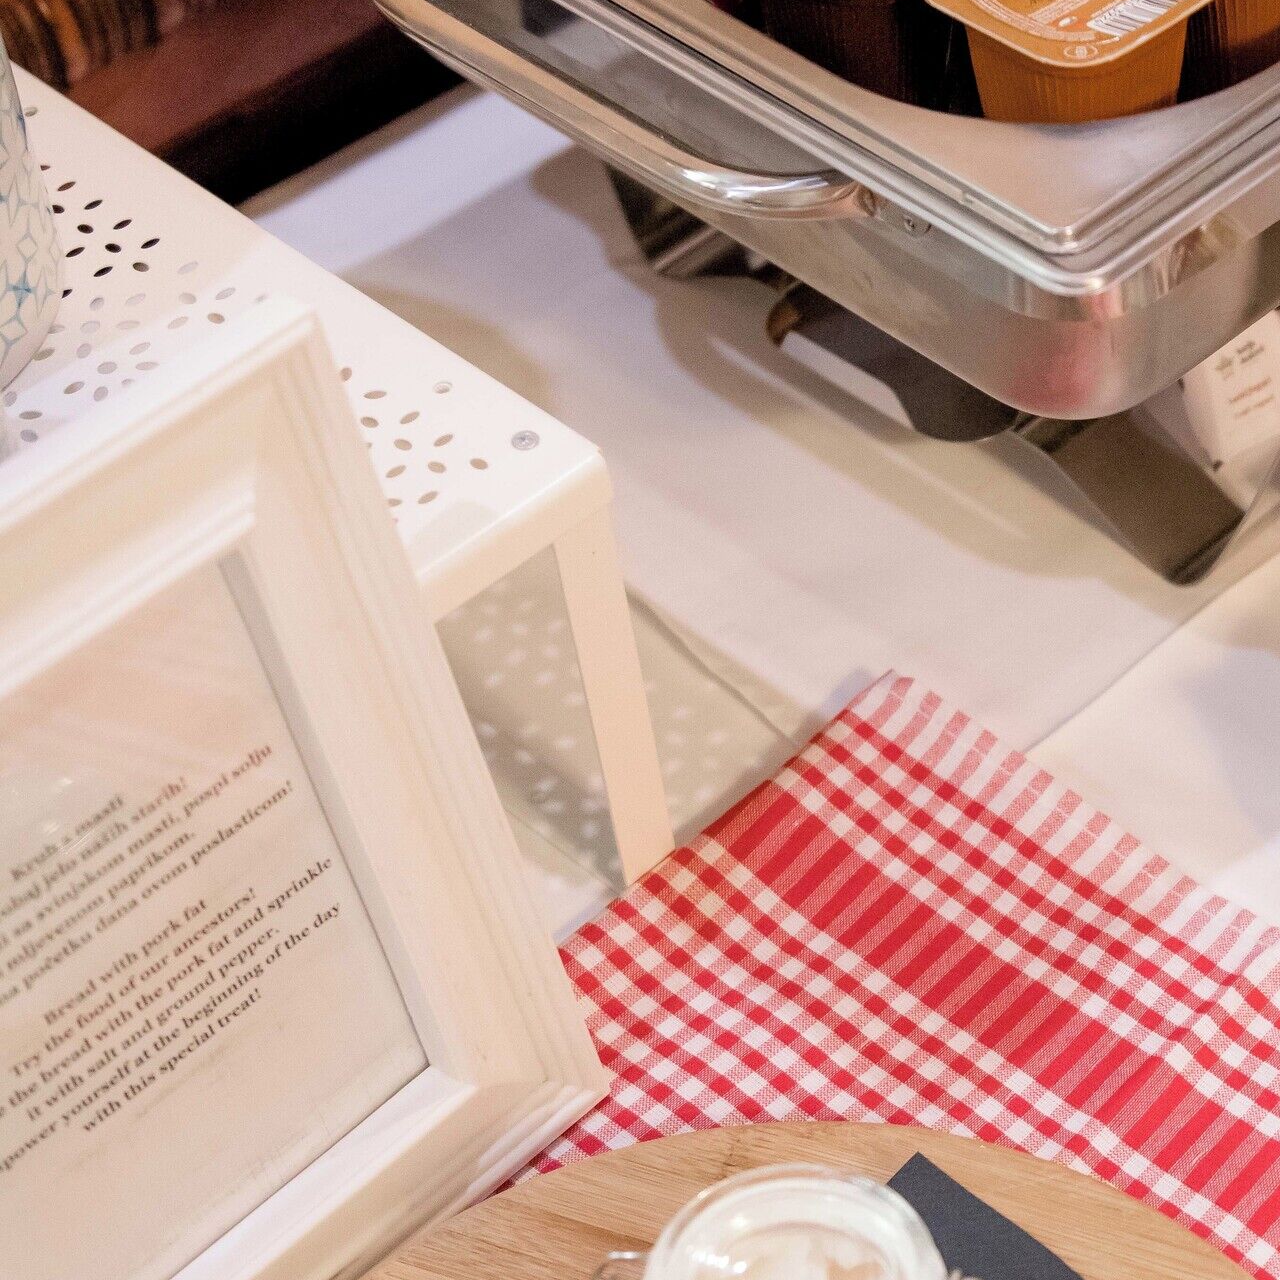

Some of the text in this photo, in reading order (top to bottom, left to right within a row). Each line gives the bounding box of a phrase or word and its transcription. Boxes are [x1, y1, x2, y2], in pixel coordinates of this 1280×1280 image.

[95, 898, 139, 934] dana
[141, 861, 189, 901] ovom
[190, 778, 292, 867] poslasticom!
[8, 856, 333, 1108] the bread with the pork fat and sprinkle
[43, 898, 208, 1026] Bread with pork fat
[44, 1026, 74, 1053] the
[76, 992, 116, 1030] food
[119, 974, 137, 998] of
[140, 953, 170, 983] our
[172, 885, 258, 958] ancestors!
[45, 1074, 85, 1108] with
[87, 1047, 118, 1076] salt
[121, 1019, 153, 1051] and
[155, 969, 216, 1029] ground
[218, 927, 280, 980] pepper.
[61, 902, 341, 1128] yourself at the beginning of the day
[83, 986, 262, 1133] with this special treat!
